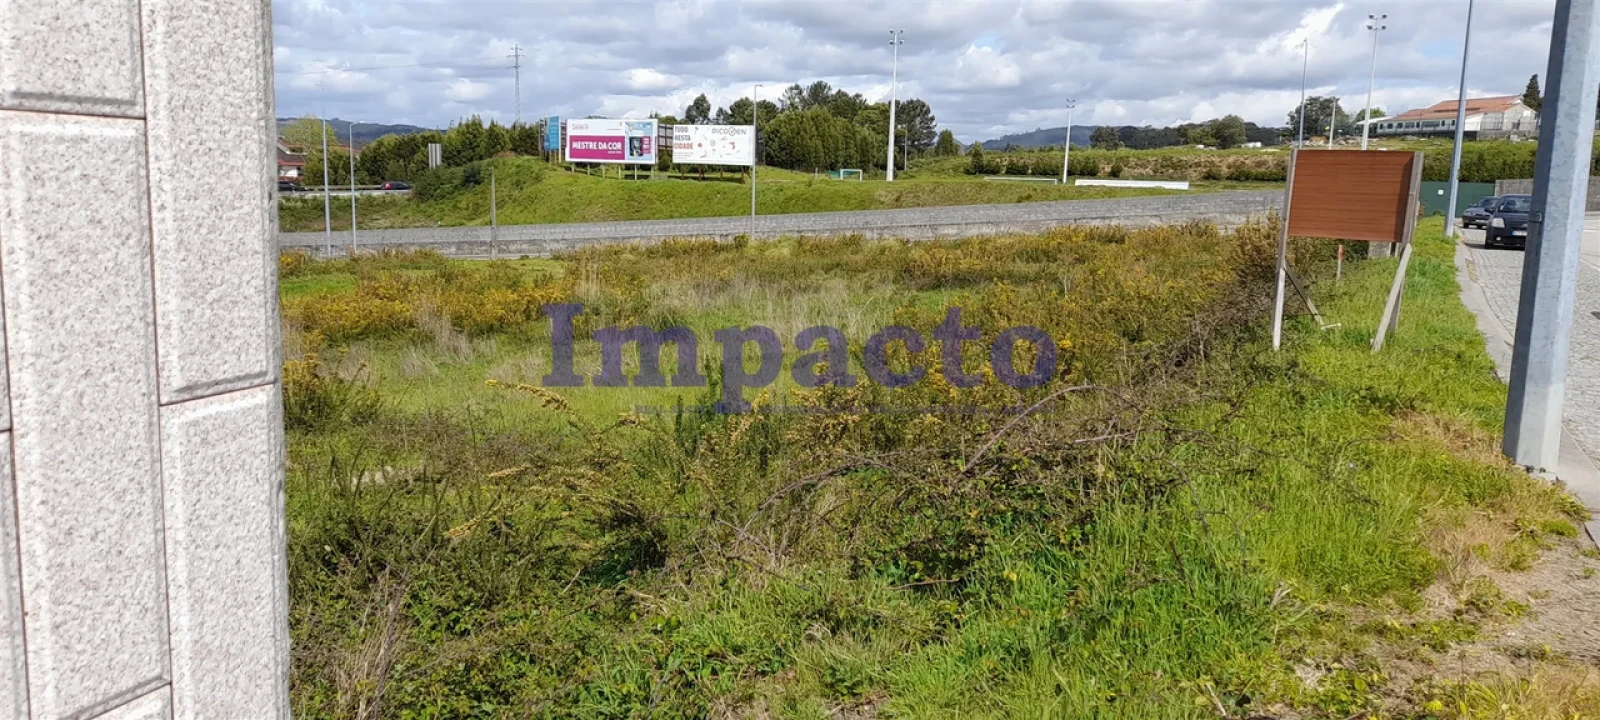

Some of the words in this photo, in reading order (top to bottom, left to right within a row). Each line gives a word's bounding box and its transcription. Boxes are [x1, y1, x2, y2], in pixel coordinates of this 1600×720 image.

[572, 141, 597, 150] MESTRE
[598, 141, 607, 150] DA
[608, 142, 622, 151] COR
